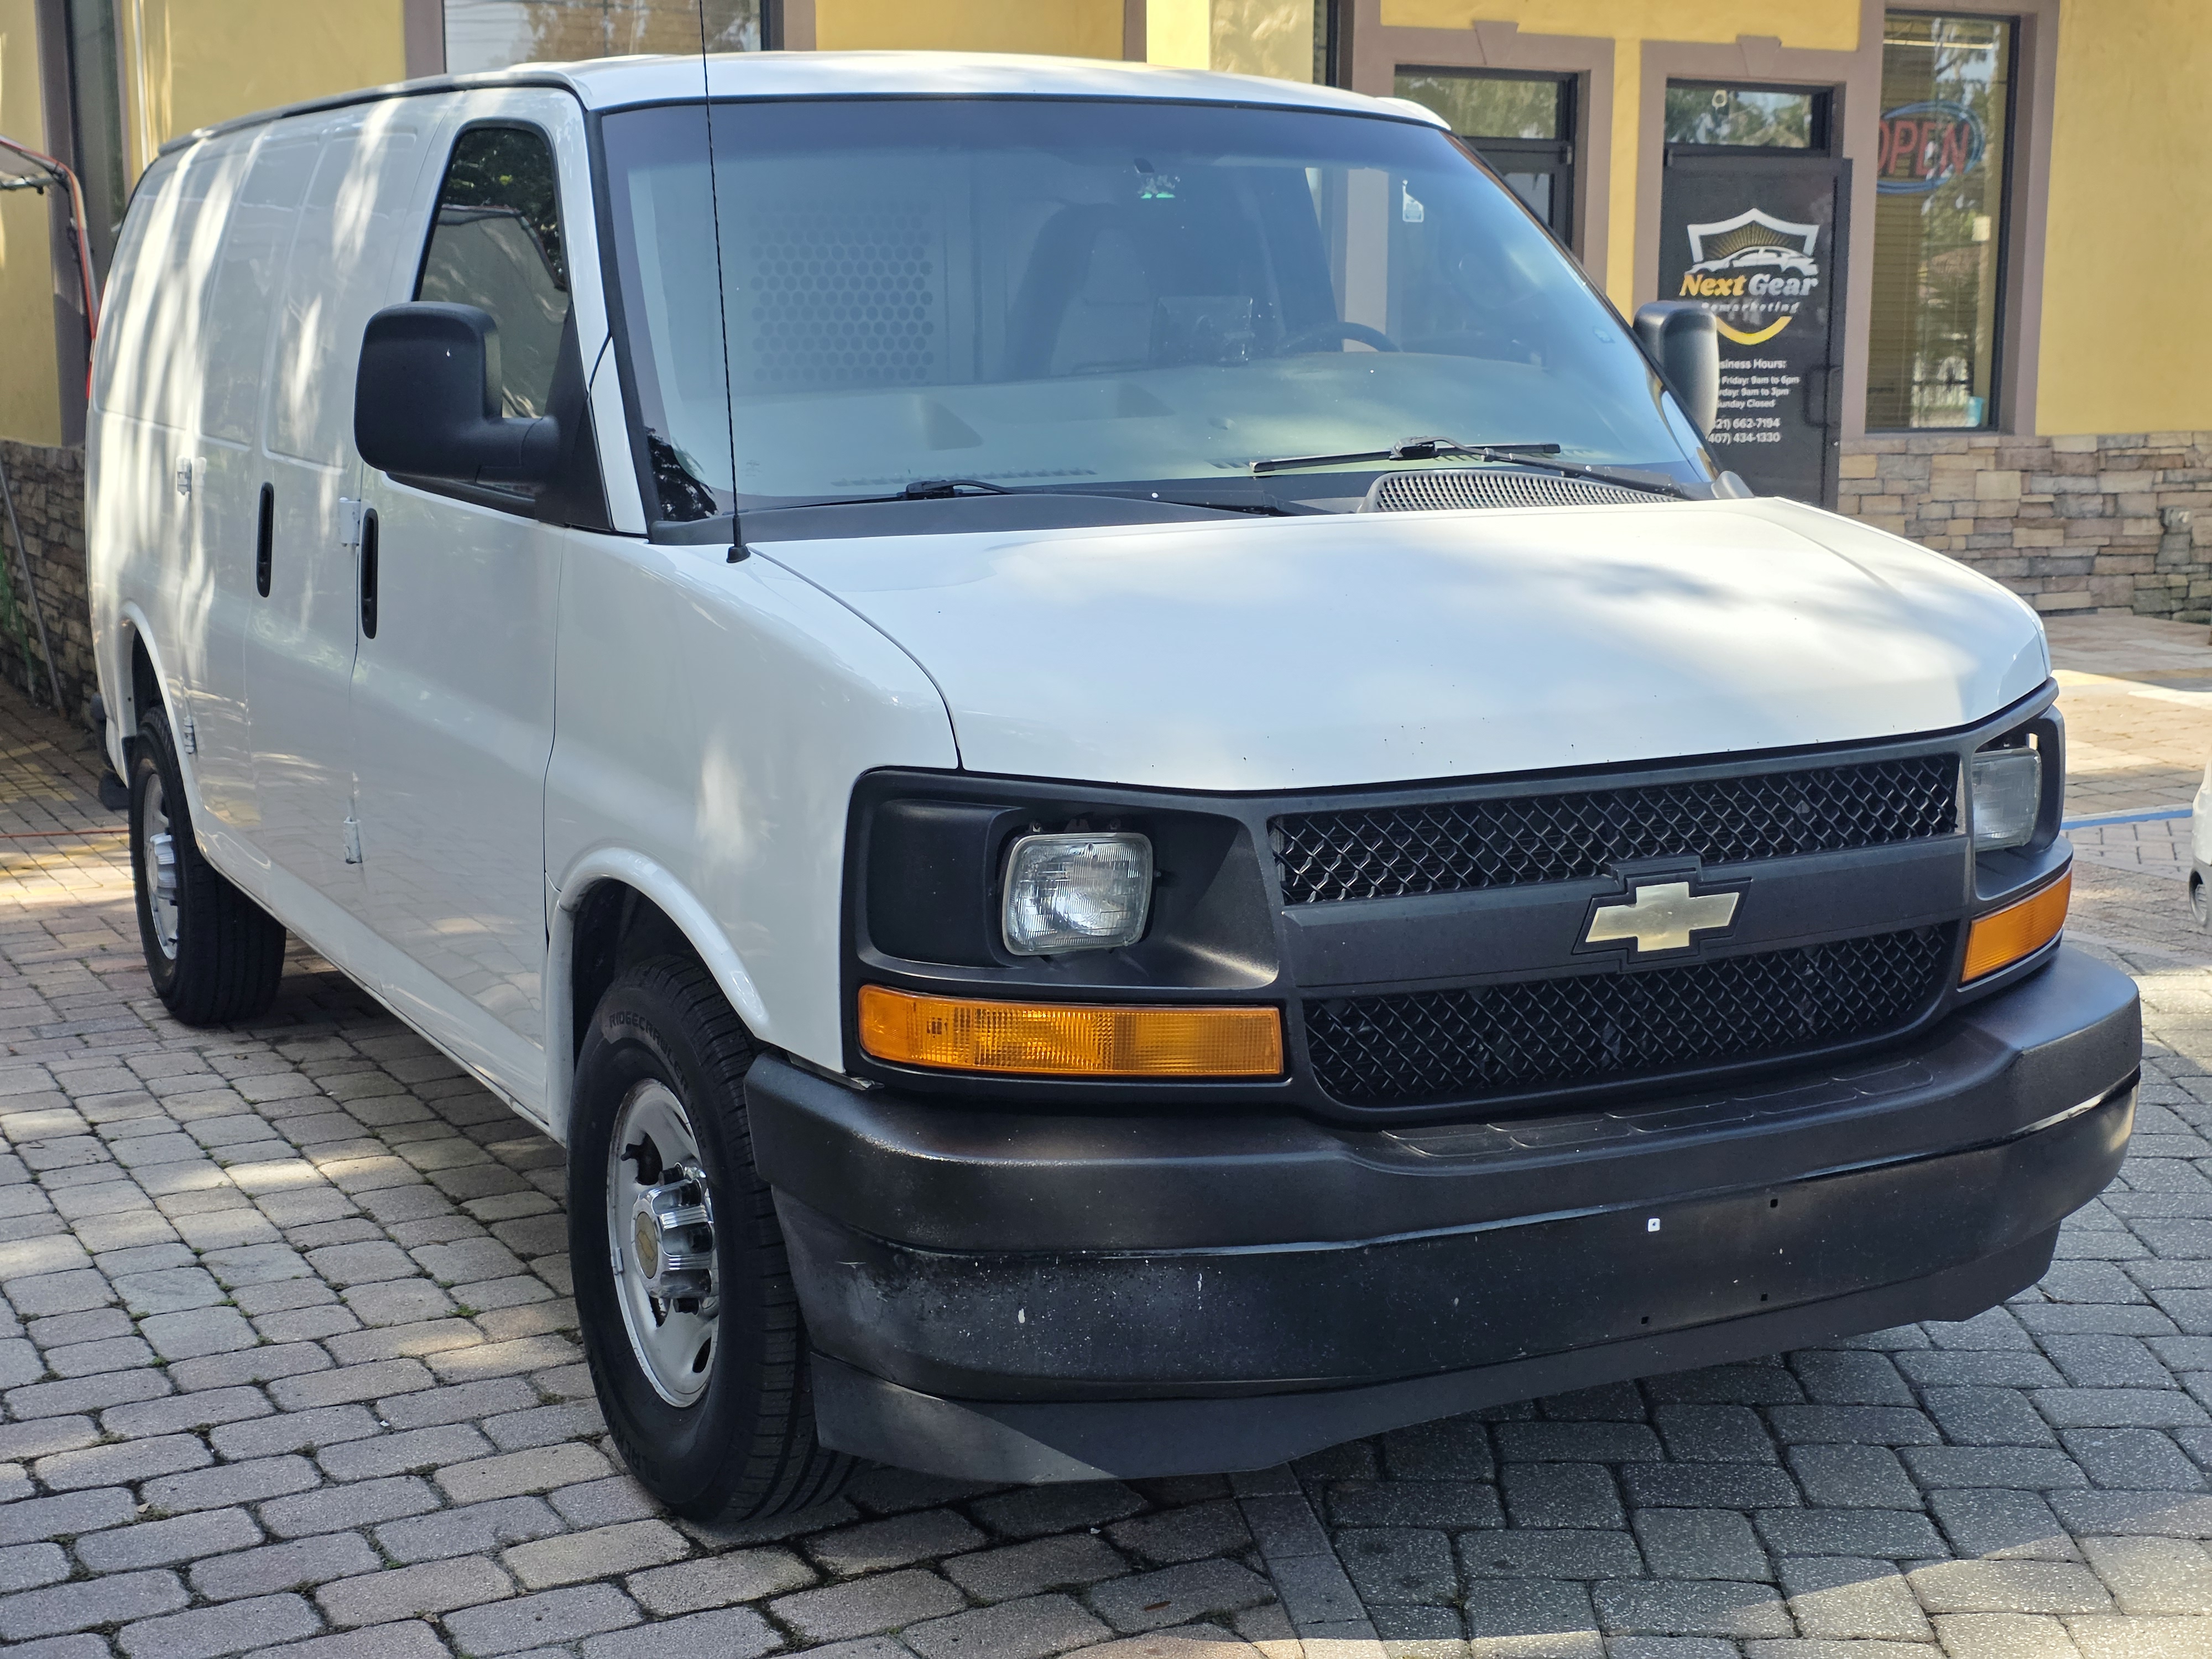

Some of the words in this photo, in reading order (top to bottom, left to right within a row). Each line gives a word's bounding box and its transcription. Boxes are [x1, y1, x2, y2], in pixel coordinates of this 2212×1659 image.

[1679, 274, 1747, 296] Next
[1748, 273, 1819, 296] Gear
[1719, 359, 1752, 369] siness
[1753, 358, 1787, 369] Hours:
[1771, 376, 1780, 384] to
[1746, 399, 1776, 408] Closed
[1715, 418, 1731, 430] 21)
[1707, 432, 1731, 446] 407)
[608, 1010, 689, 1094] RIDGECRAWLER
